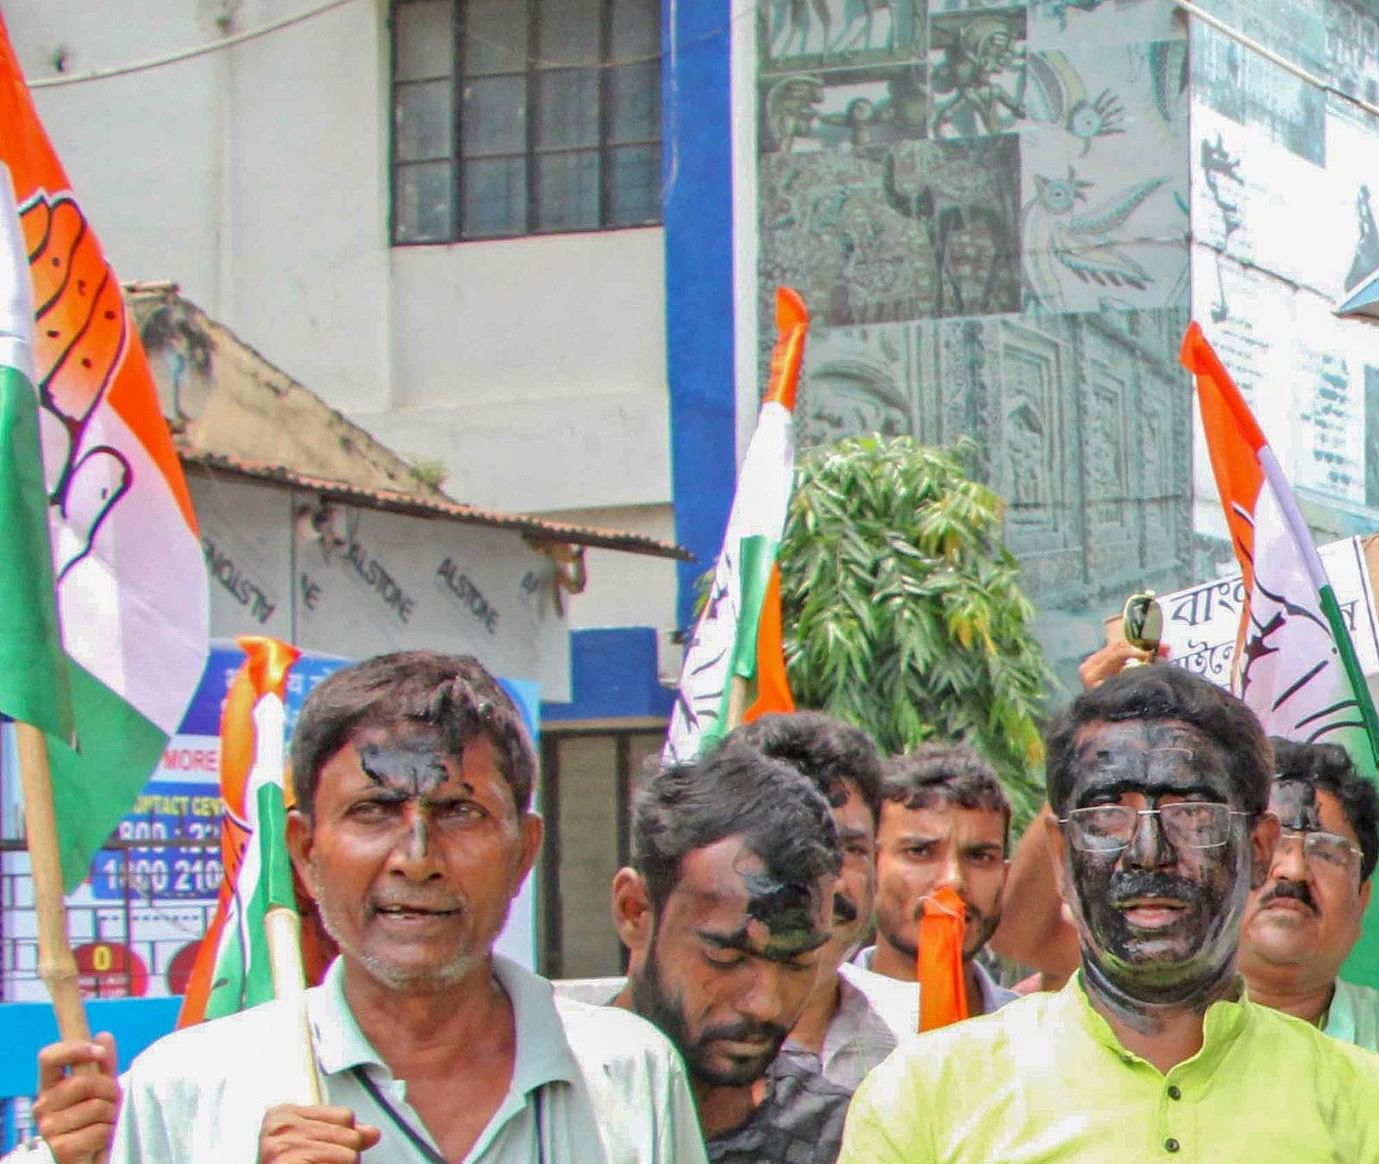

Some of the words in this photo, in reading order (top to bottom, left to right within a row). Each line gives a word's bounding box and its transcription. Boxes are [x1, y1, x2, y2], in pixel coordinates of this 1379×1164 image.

[436, 557, 500, 635] ALSTONE
[163, 749, 217, 771] MORE
[173, 859, 223, 893] 210
